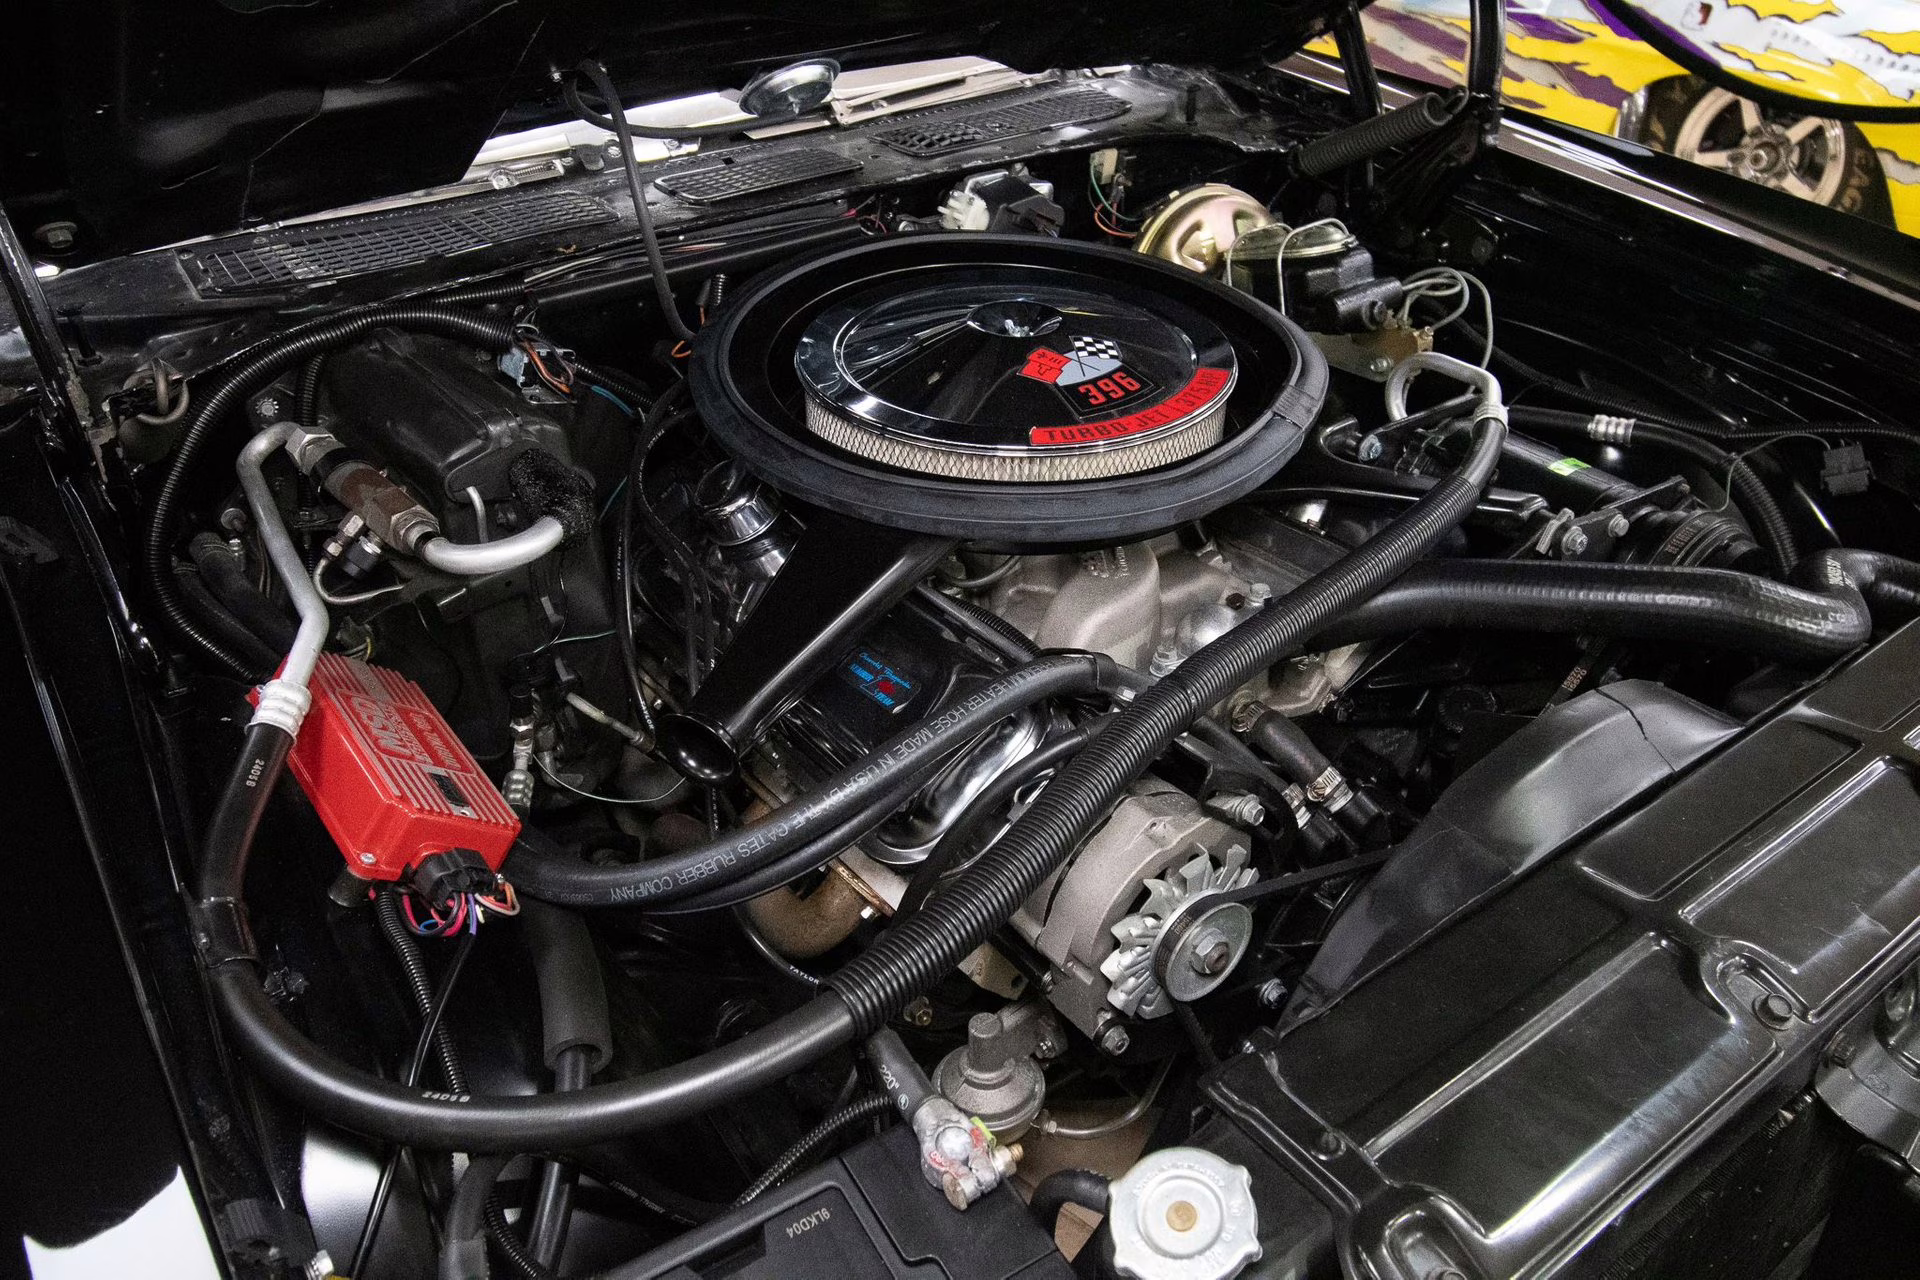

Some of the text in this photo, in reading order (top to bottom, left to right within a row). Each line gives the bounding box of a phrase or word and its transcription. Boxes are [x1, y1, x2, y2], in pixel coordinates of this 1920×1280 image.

[1078, 371, 1141, 405] 396
[966, 680, 1012, 711] HEATER
[351, 697, 416, 757] MSD
[930, 708, 967, 734] HOSE
[893, 728, 932, 760] MADE
[877, 753, 896, 770] IN
[737, 822, 789, 858] GATES
[677, 850, 736, 886] RUBBER
[609, 875, 673, 902] COMPANY
[788, 964, 821, 985] TAYLOR
[786, 1206, 831, 1240] 9LKD04
